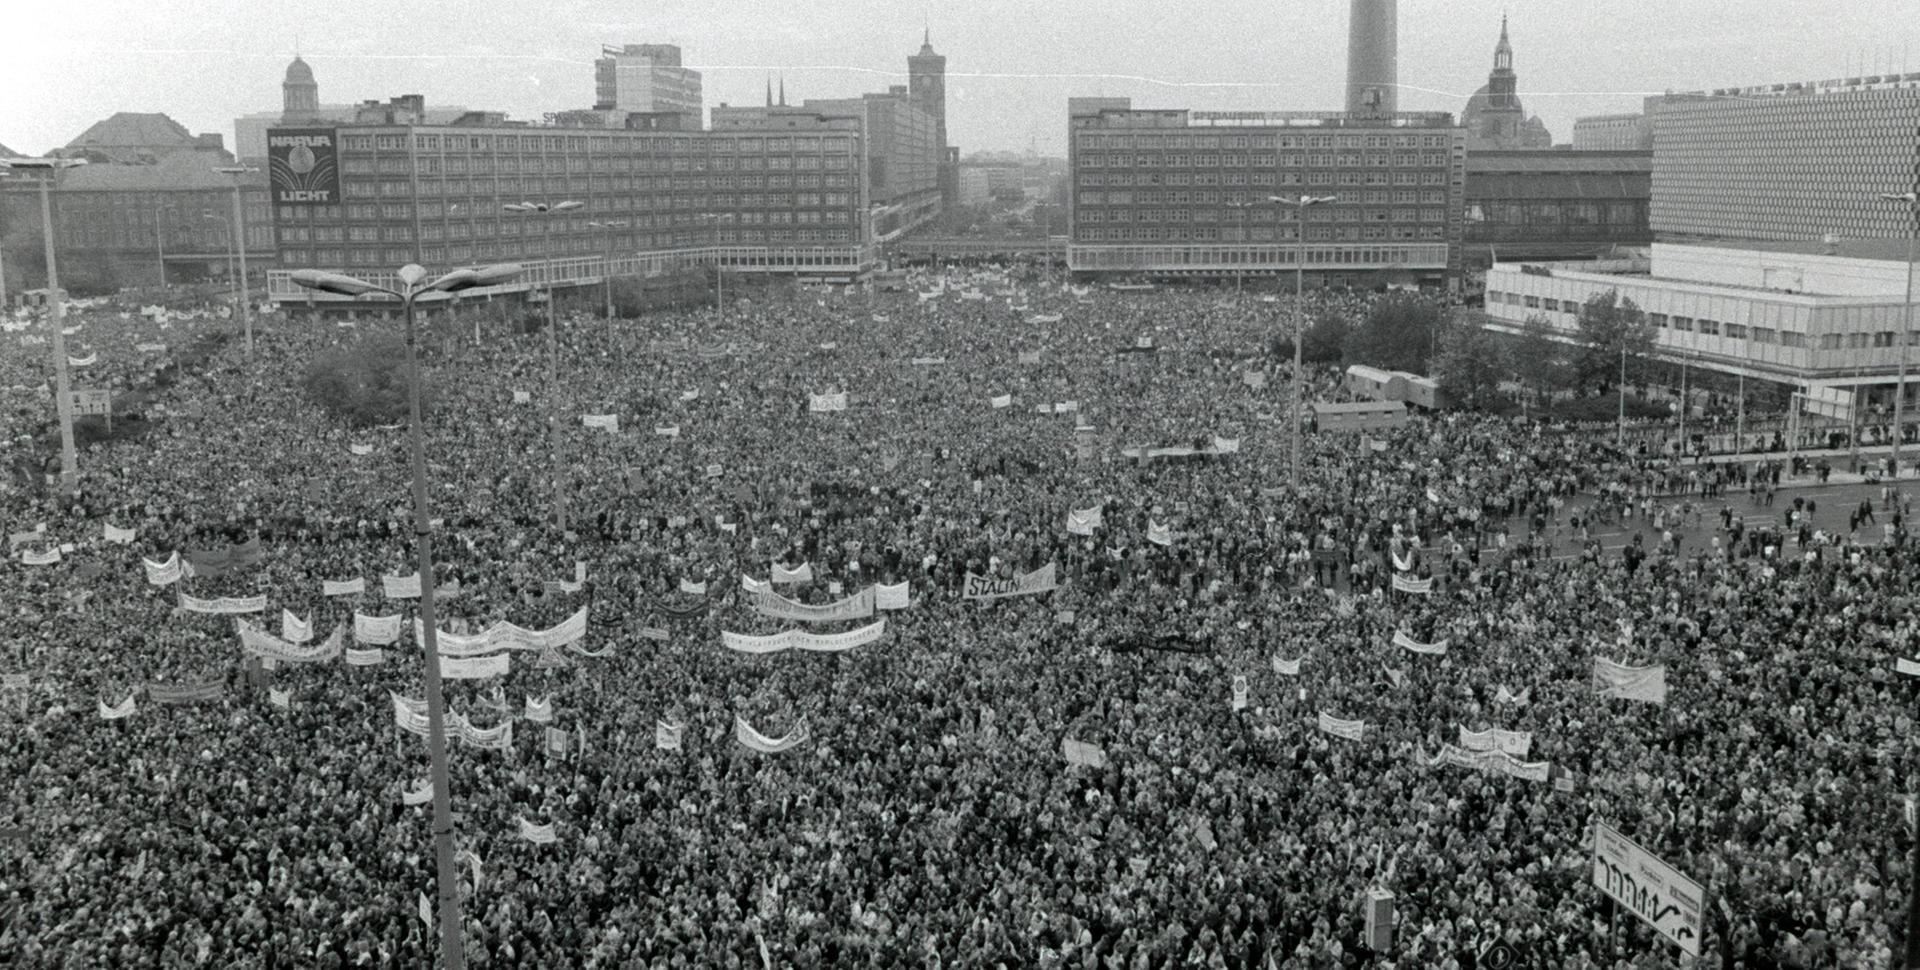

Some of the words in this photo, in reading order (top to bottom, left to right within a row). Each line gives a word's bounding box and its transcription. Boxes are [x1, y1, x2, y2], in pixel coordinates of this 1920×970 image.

[270, 135, 331, 147] NARVA
[280, 190, 330, 202] LICHT
[968, 576, 1021, 597] STALIN
